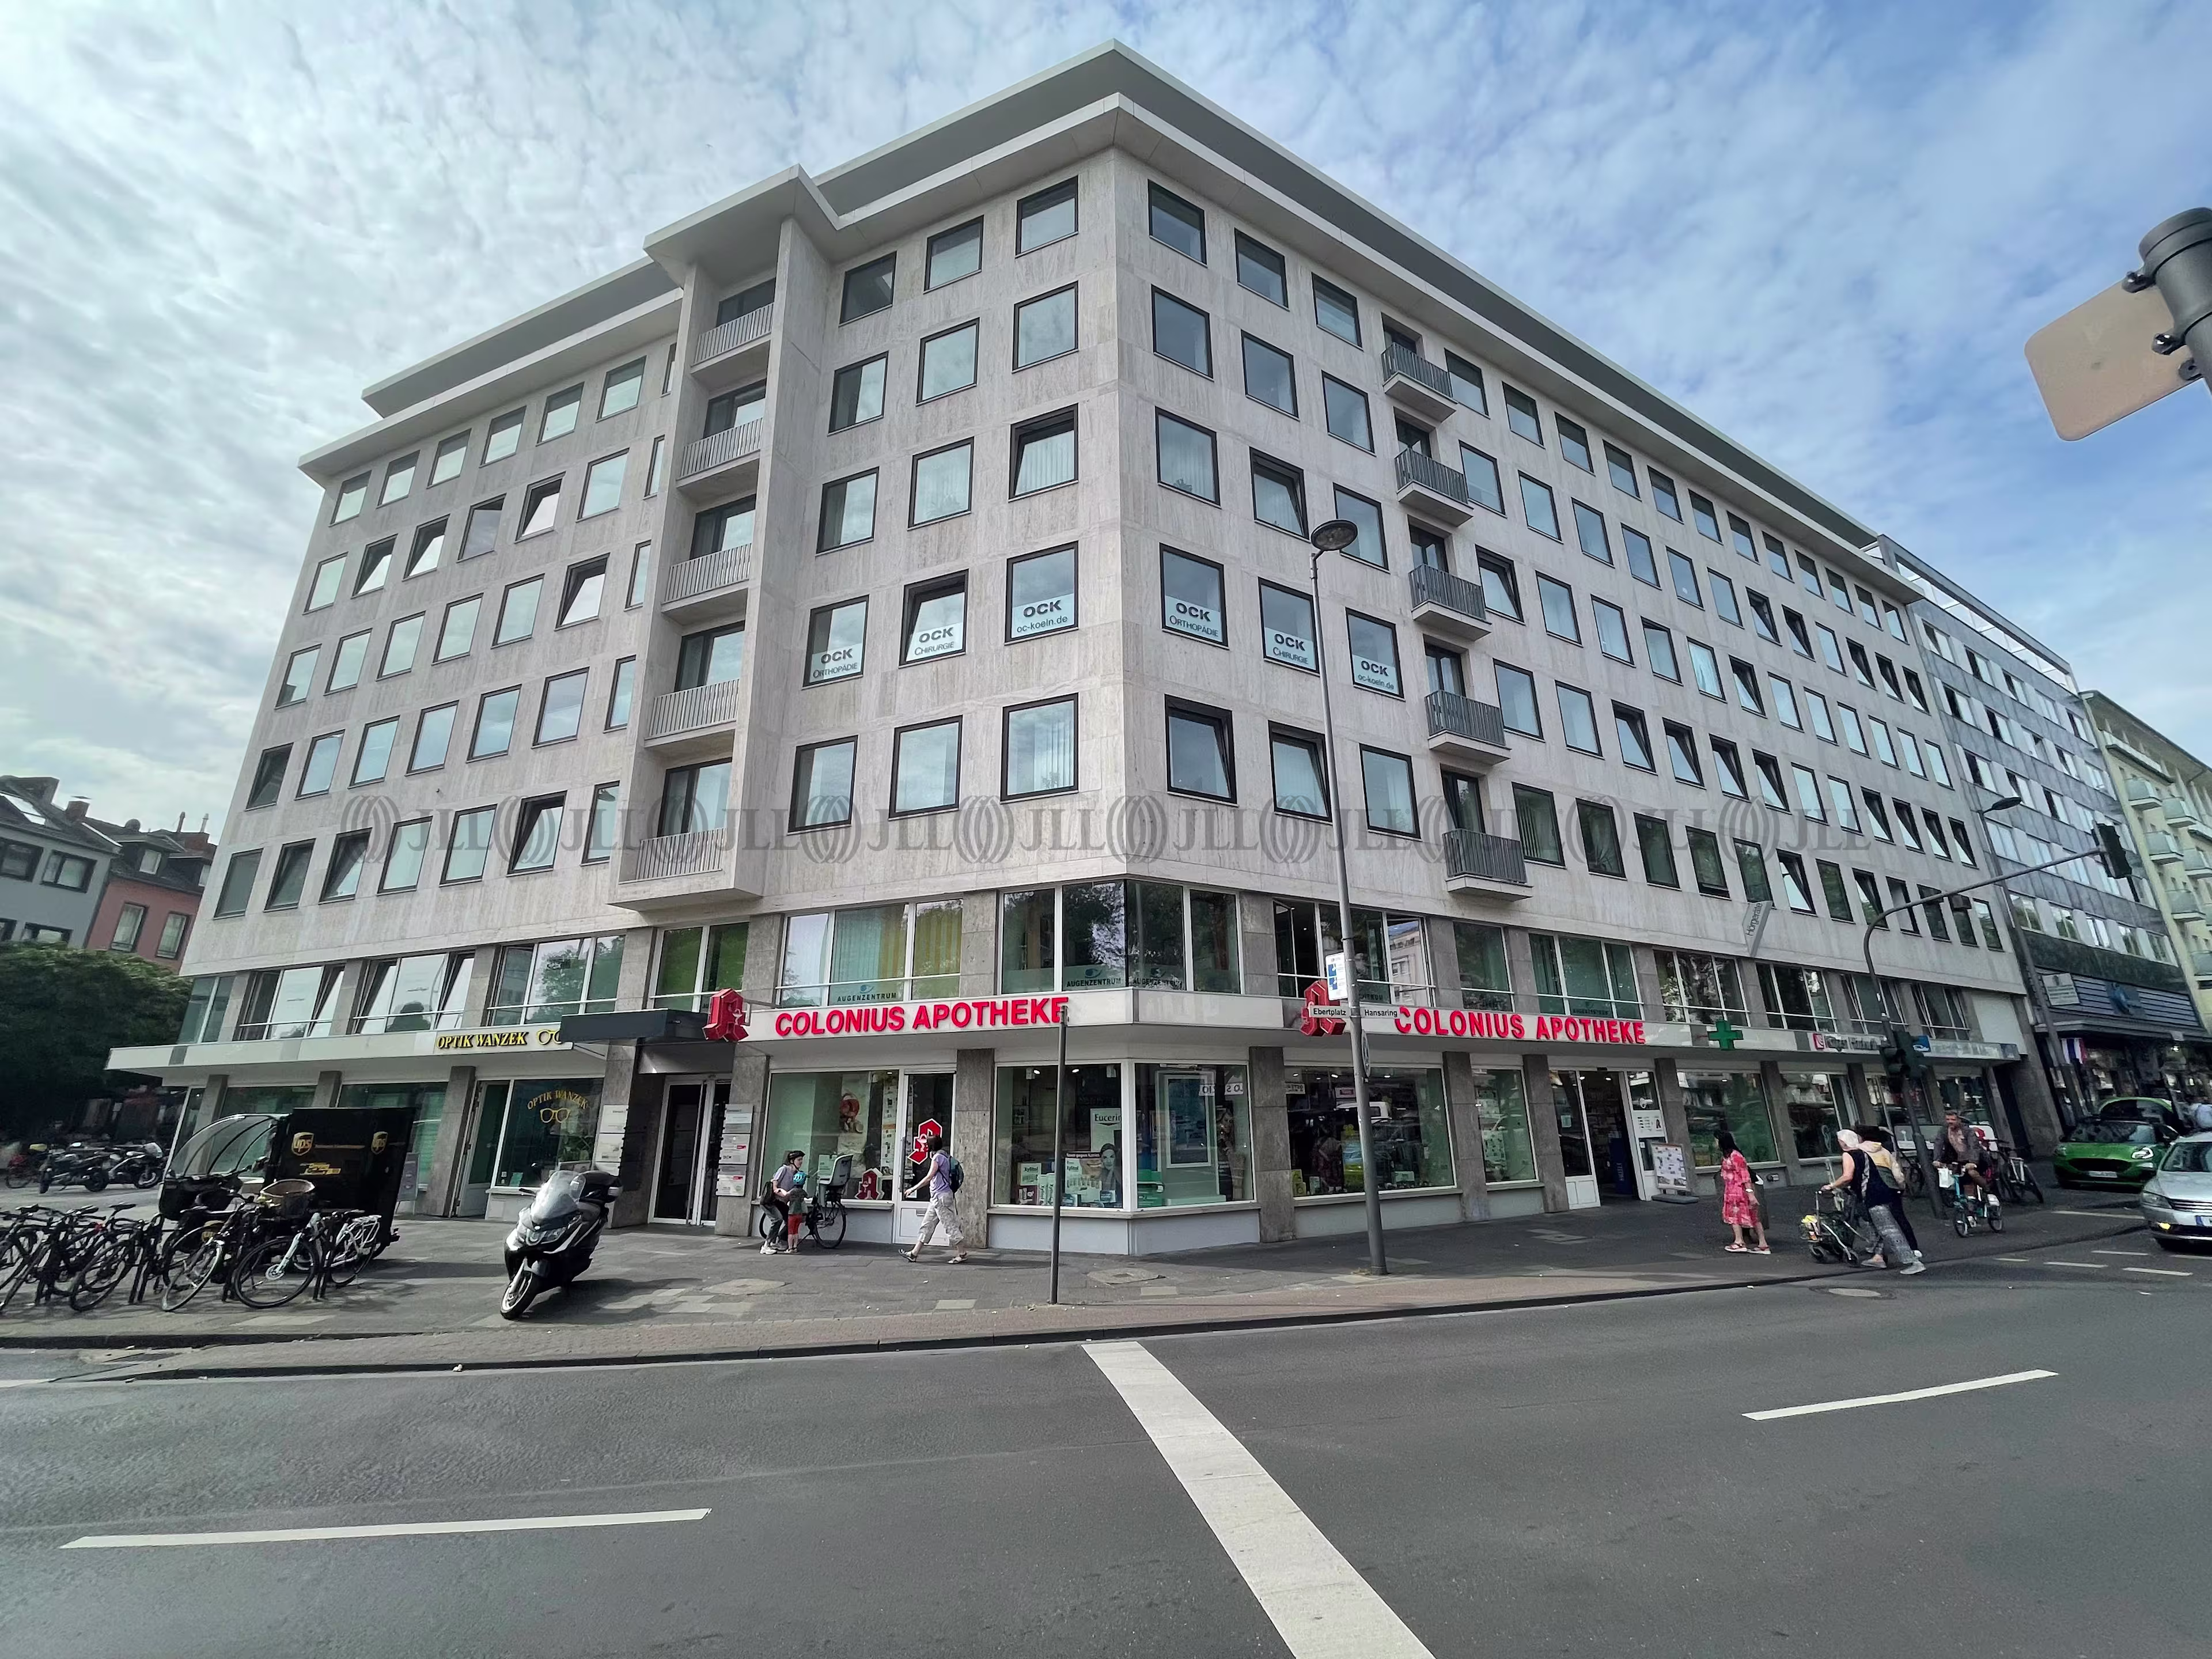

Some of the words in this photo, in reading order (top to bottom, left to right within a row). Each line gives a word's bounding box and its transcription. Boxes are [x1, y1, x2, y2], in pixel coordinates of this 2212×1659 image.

[1023, 599, 1062, 618] OCK
[1176, 602, 1211, 622] OCK
[1016, 615, 1069, 633] oc-koeln.de
[918, 627, 954, 643] OCK
[1274, 633, 1306, 652] OCK
[820, 648, 853, 665] OCK
[1361, 660, 1389, 677] OCK
[1357, 674, 1395, 690] oc-koeln.de
[837, 993, 896, 1002] AUGENZENTRUM
[775, 1006, 905, 1037] COLONIUS
[912, 997, 1069, 1030] APOTHEKE
[1313, 1008, 1346, 1016] Ebertplatz
[1365, 1009, 1398, 1017] Hansaring
[1395, 1006, 1525, 1039] COLONIUS
[1536, 1016, 1646, 1044] APOTHEKE
[437, 1035, 475, 1049] OPTIK
[475, 1032, 529, 1047] WANZEK
[527, 1091, 552, 1109] OPTIK
[555, 1090, 588, 1109] WANZEK
[293, 1139, 312, 1152] ups
